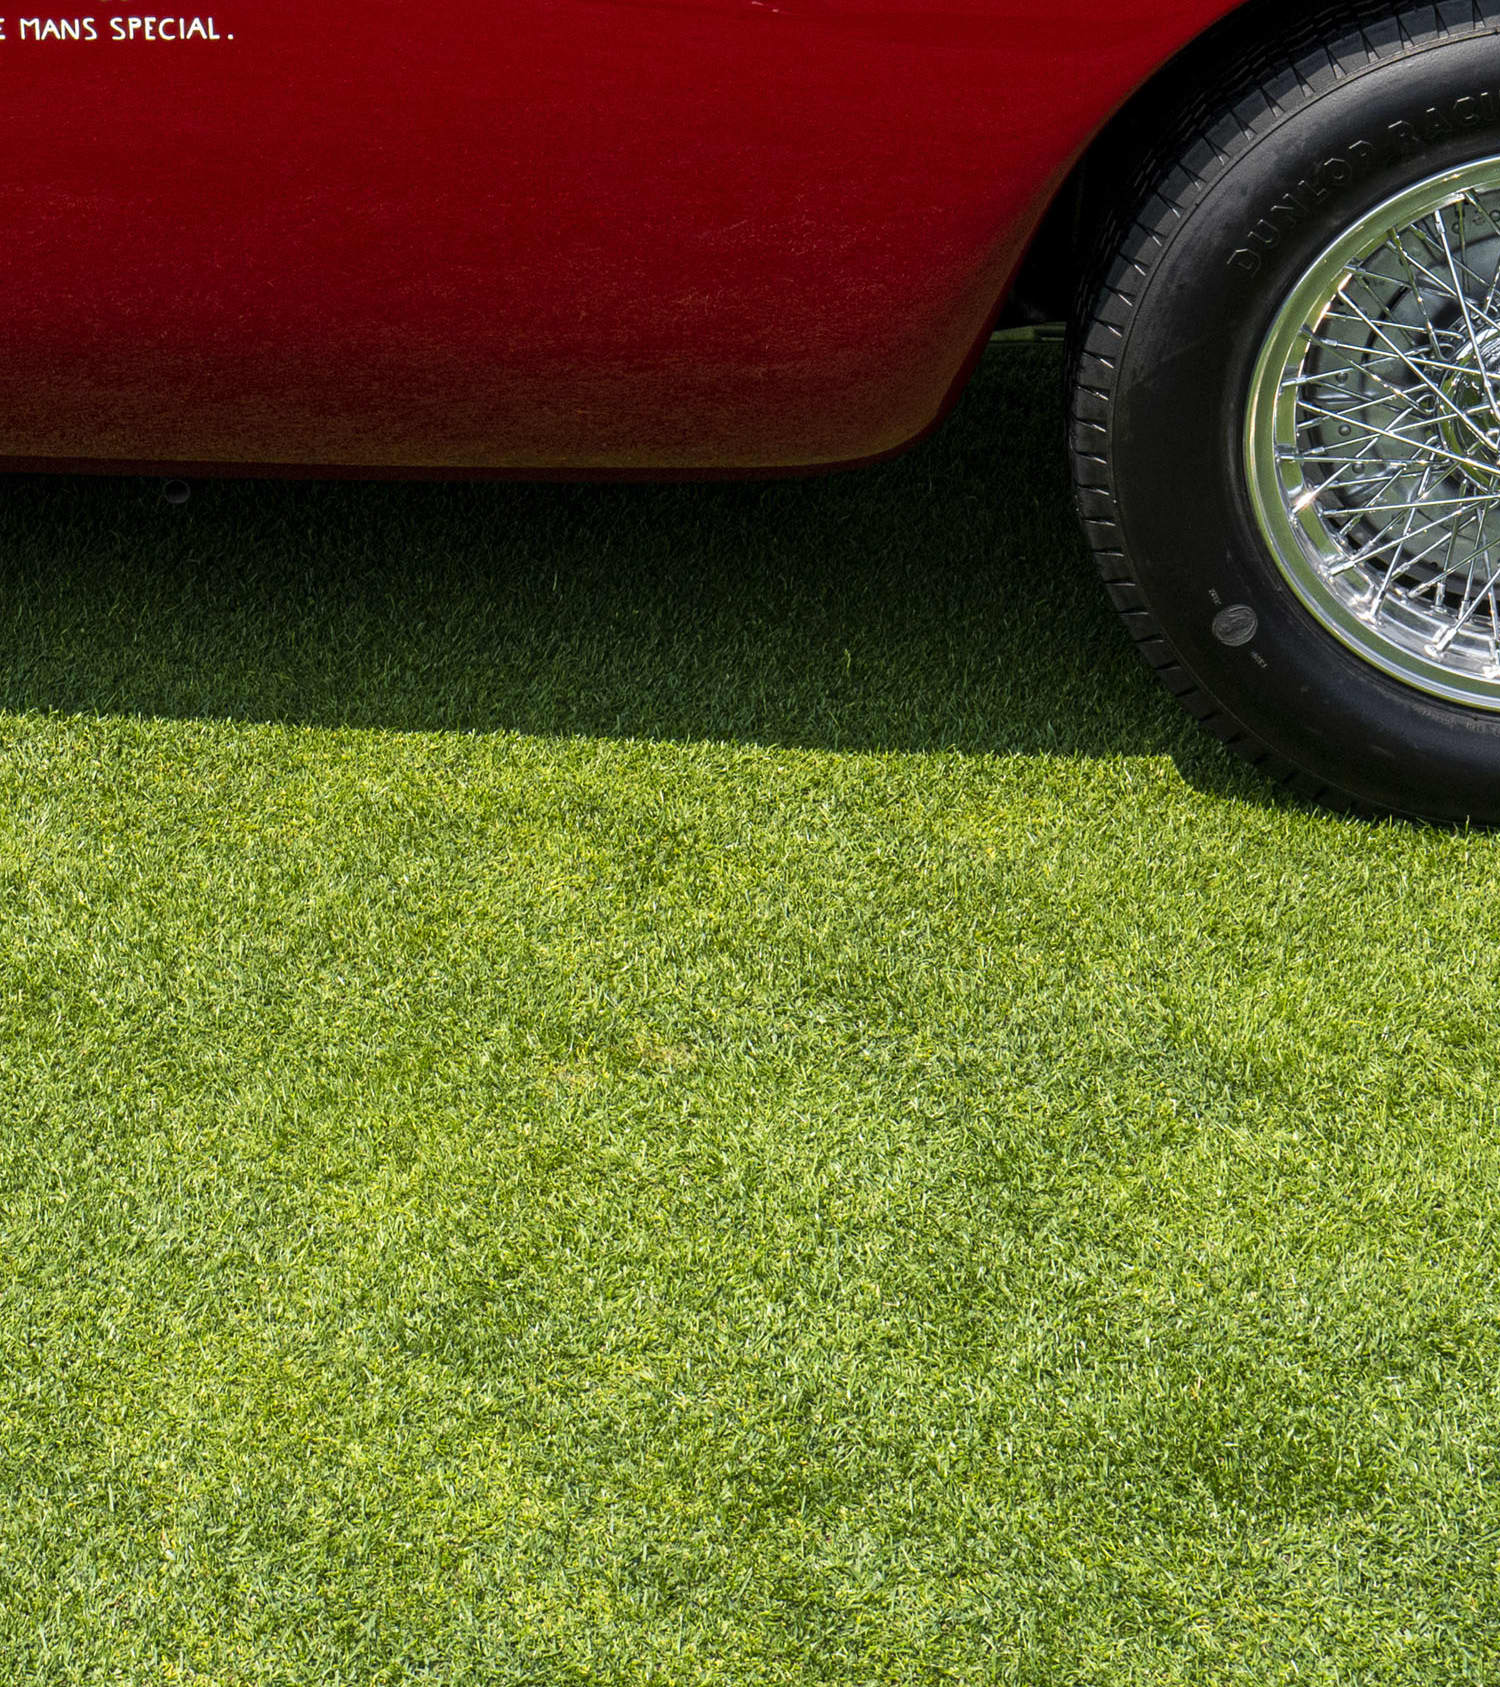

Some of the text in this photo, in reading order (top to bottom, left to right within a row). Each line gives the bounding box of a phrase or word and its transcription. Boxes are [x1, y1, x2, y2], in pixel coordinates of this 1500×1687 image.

[19, 17, 98, 41] MANS
[109, 17, 235, 41] SPECIAL.
[1226, 139, 1375, 276] DUNLOP
